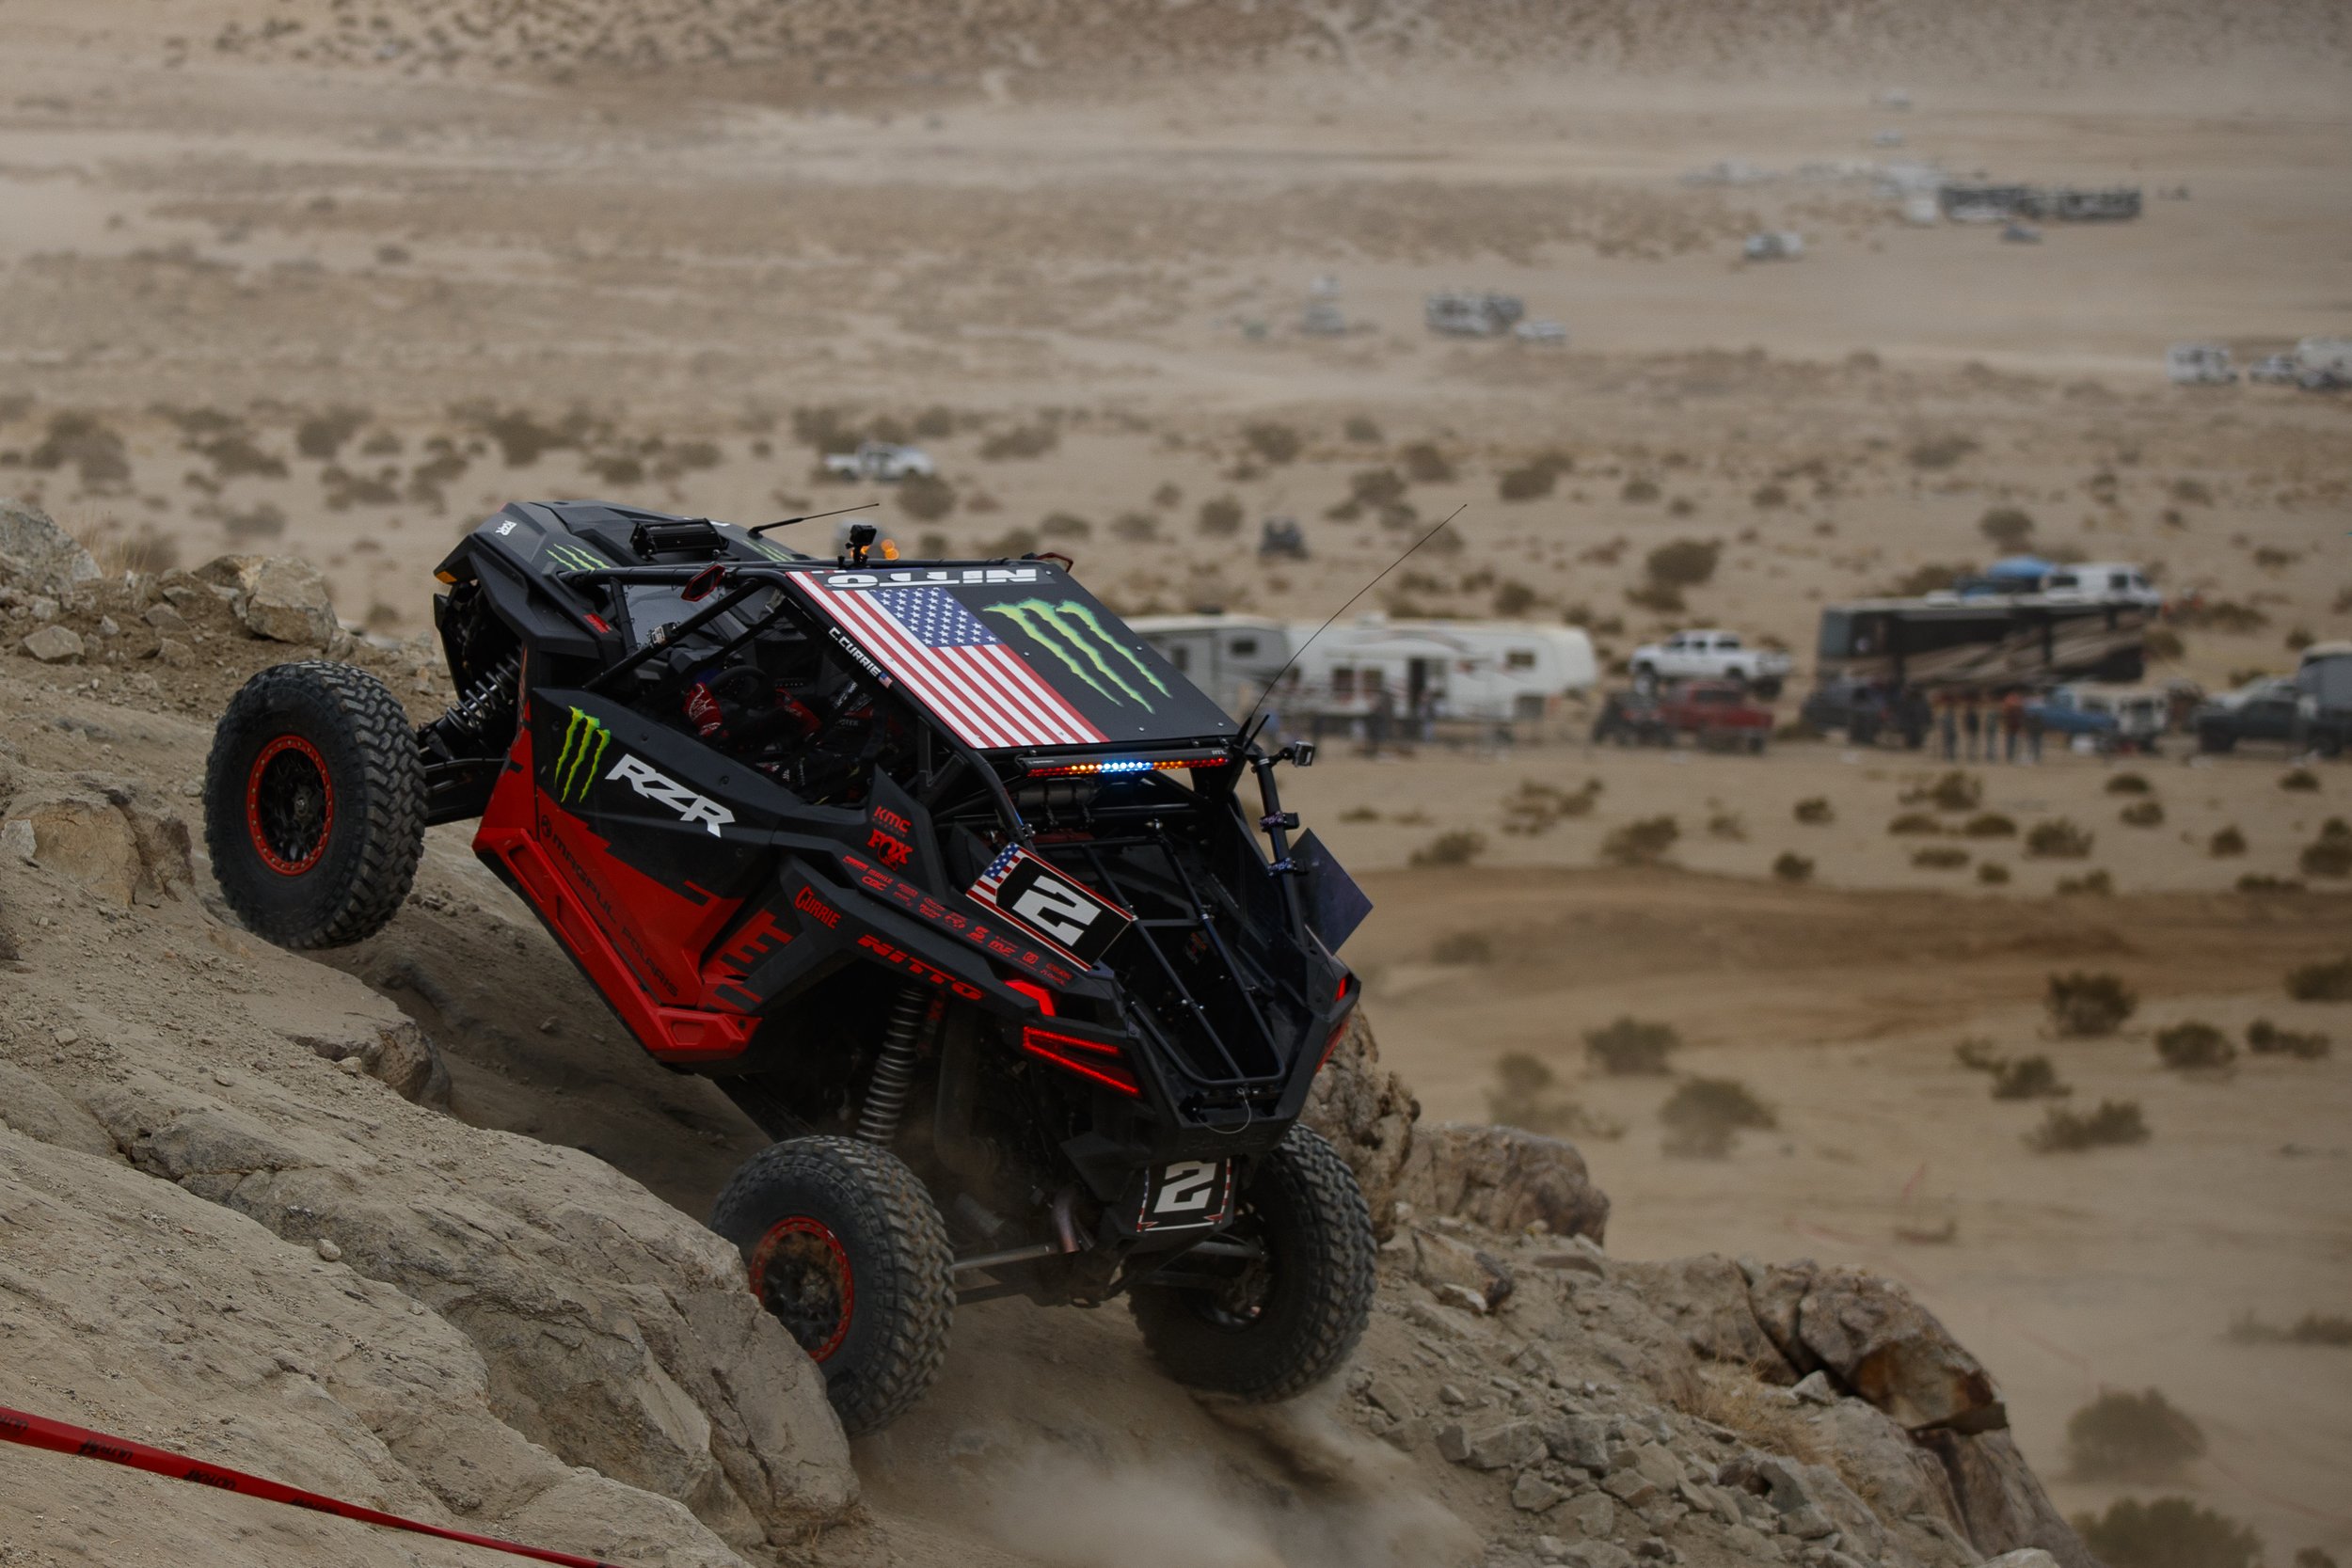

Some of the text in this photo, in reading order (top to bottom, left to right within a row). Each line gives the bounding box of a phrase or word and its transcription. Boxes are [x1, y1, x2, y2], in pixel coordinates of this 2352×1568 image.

[495, 519, 517, 536] RZR
[827, 568, 1038, 589] NITTO
[828, 626, 882, 677] C.CURRIE
[605, 753, 736, 837] RZR
[874, 805, 912, 832] KMC
[866, 828, 914, 869] FOX
[553, 836, 617, 925] MAGPUL
[794, 884, 842, 930] CURRIE
[1011, 874, 1102, 946] 2
[621, 925, 679, 997] POLARIS
[856, 933, 988, 1001] NITTO
[1153, 1159, 1217, 1214] 2
